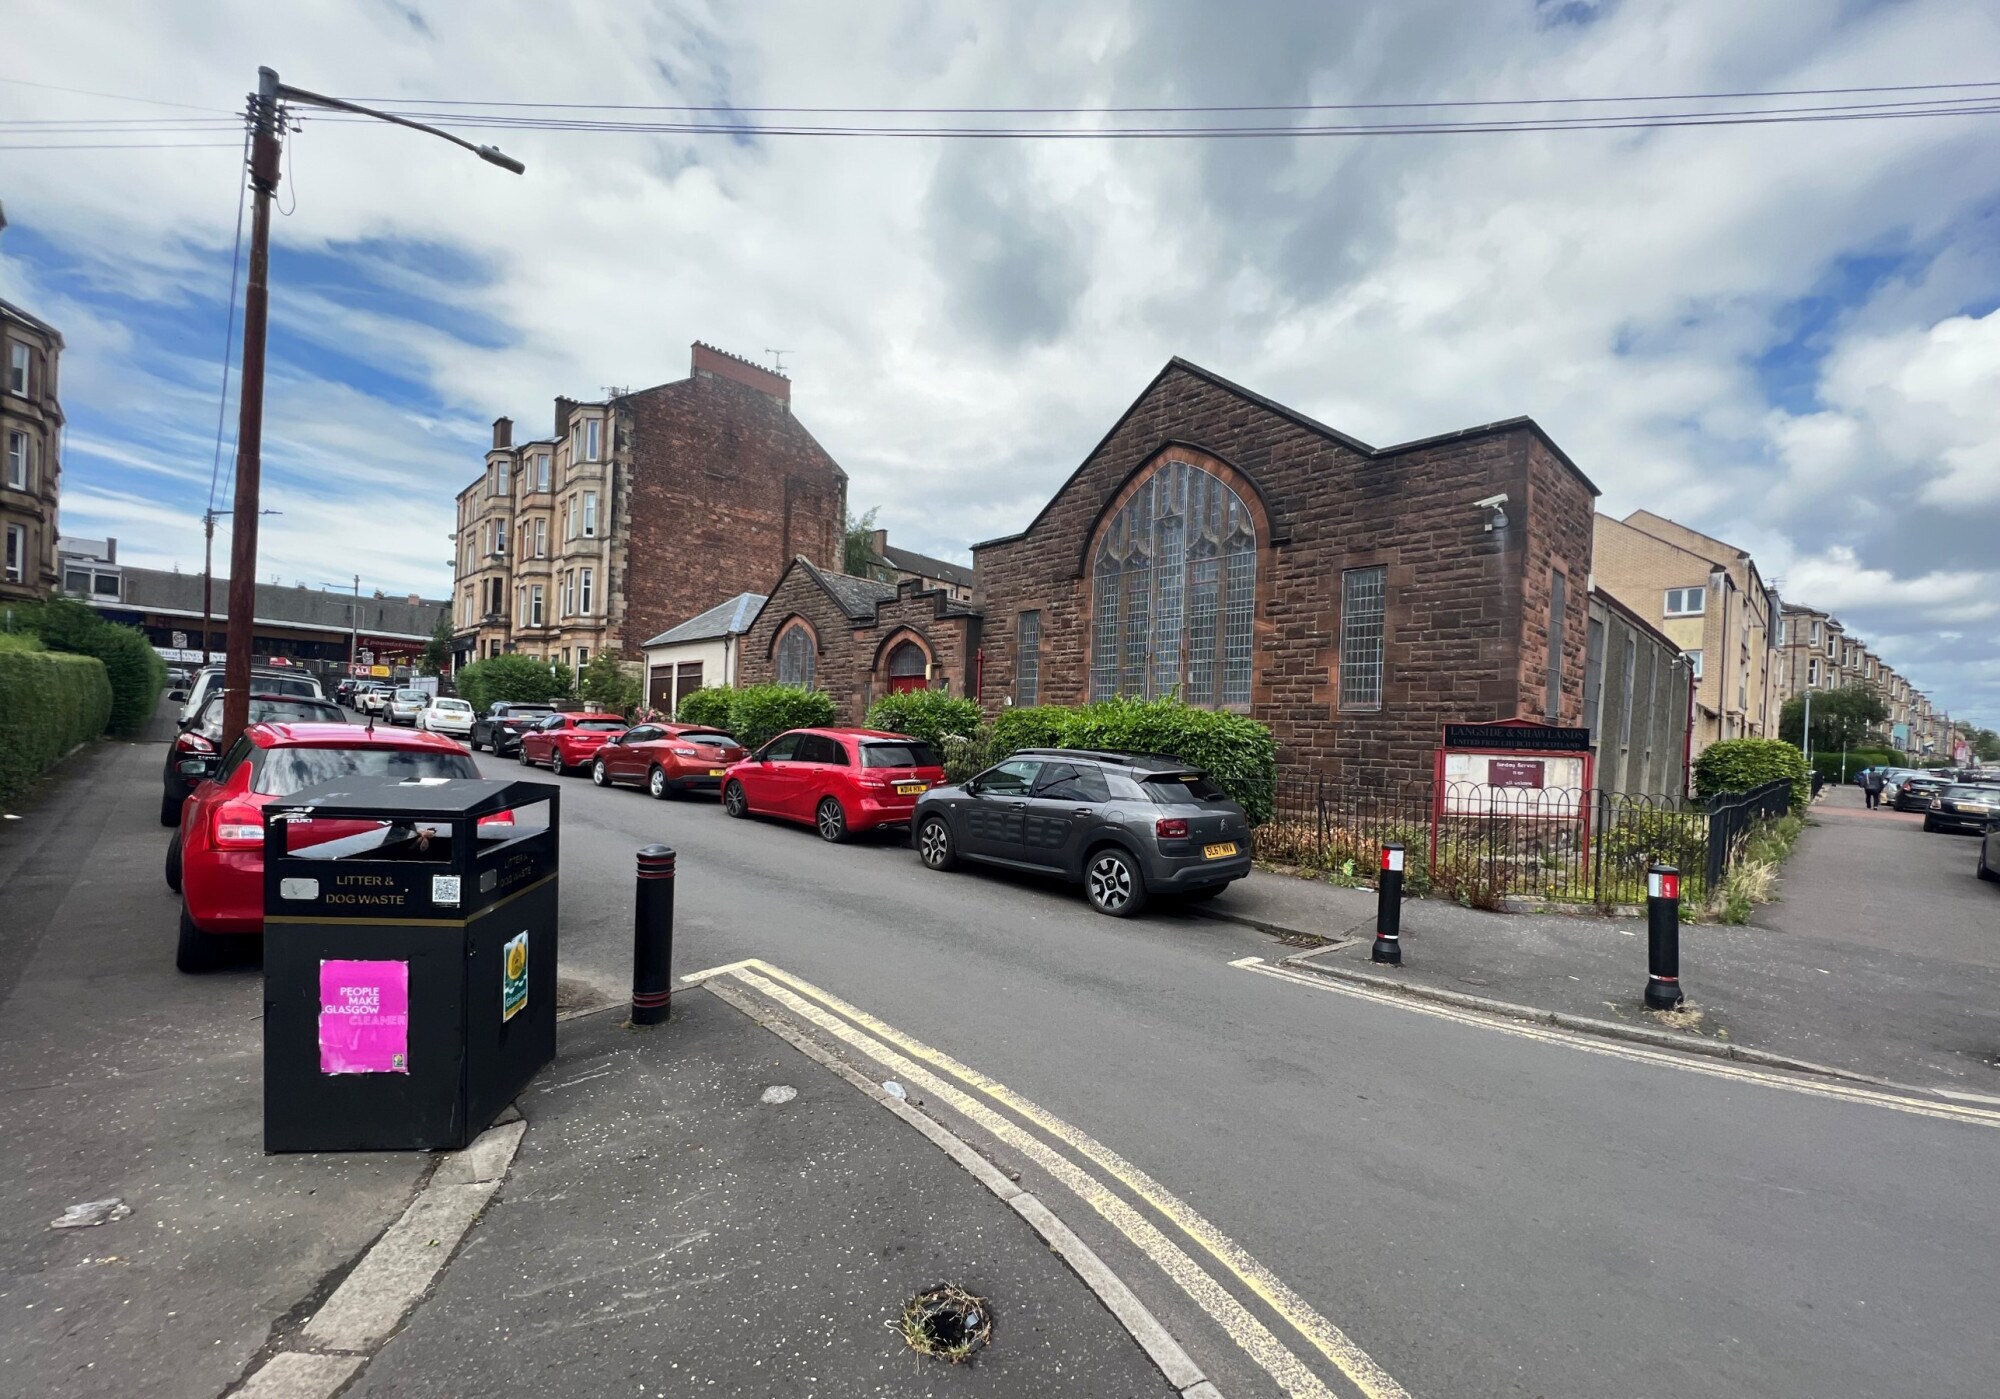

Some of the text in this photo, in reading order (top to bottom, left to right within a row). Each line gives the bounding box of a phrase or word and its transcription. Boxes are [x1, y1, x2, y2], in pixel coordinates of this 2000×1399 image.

[1450, 726, 1584, 740] LANGSIDE & SHAWLANDS
[1543, 741, 1580, 749] SCOTLAND
[336, 875, 394, 886] LITTER &
[326, 894, 405, 905] DOG WASTE
[340, 987, 379, 996] PEOPLE
[348, 996, 379, 1006] MAKE
[324, 1005, 379, 1014] GLASGOW
[348, 1015, 406, 1026] CLEANER
